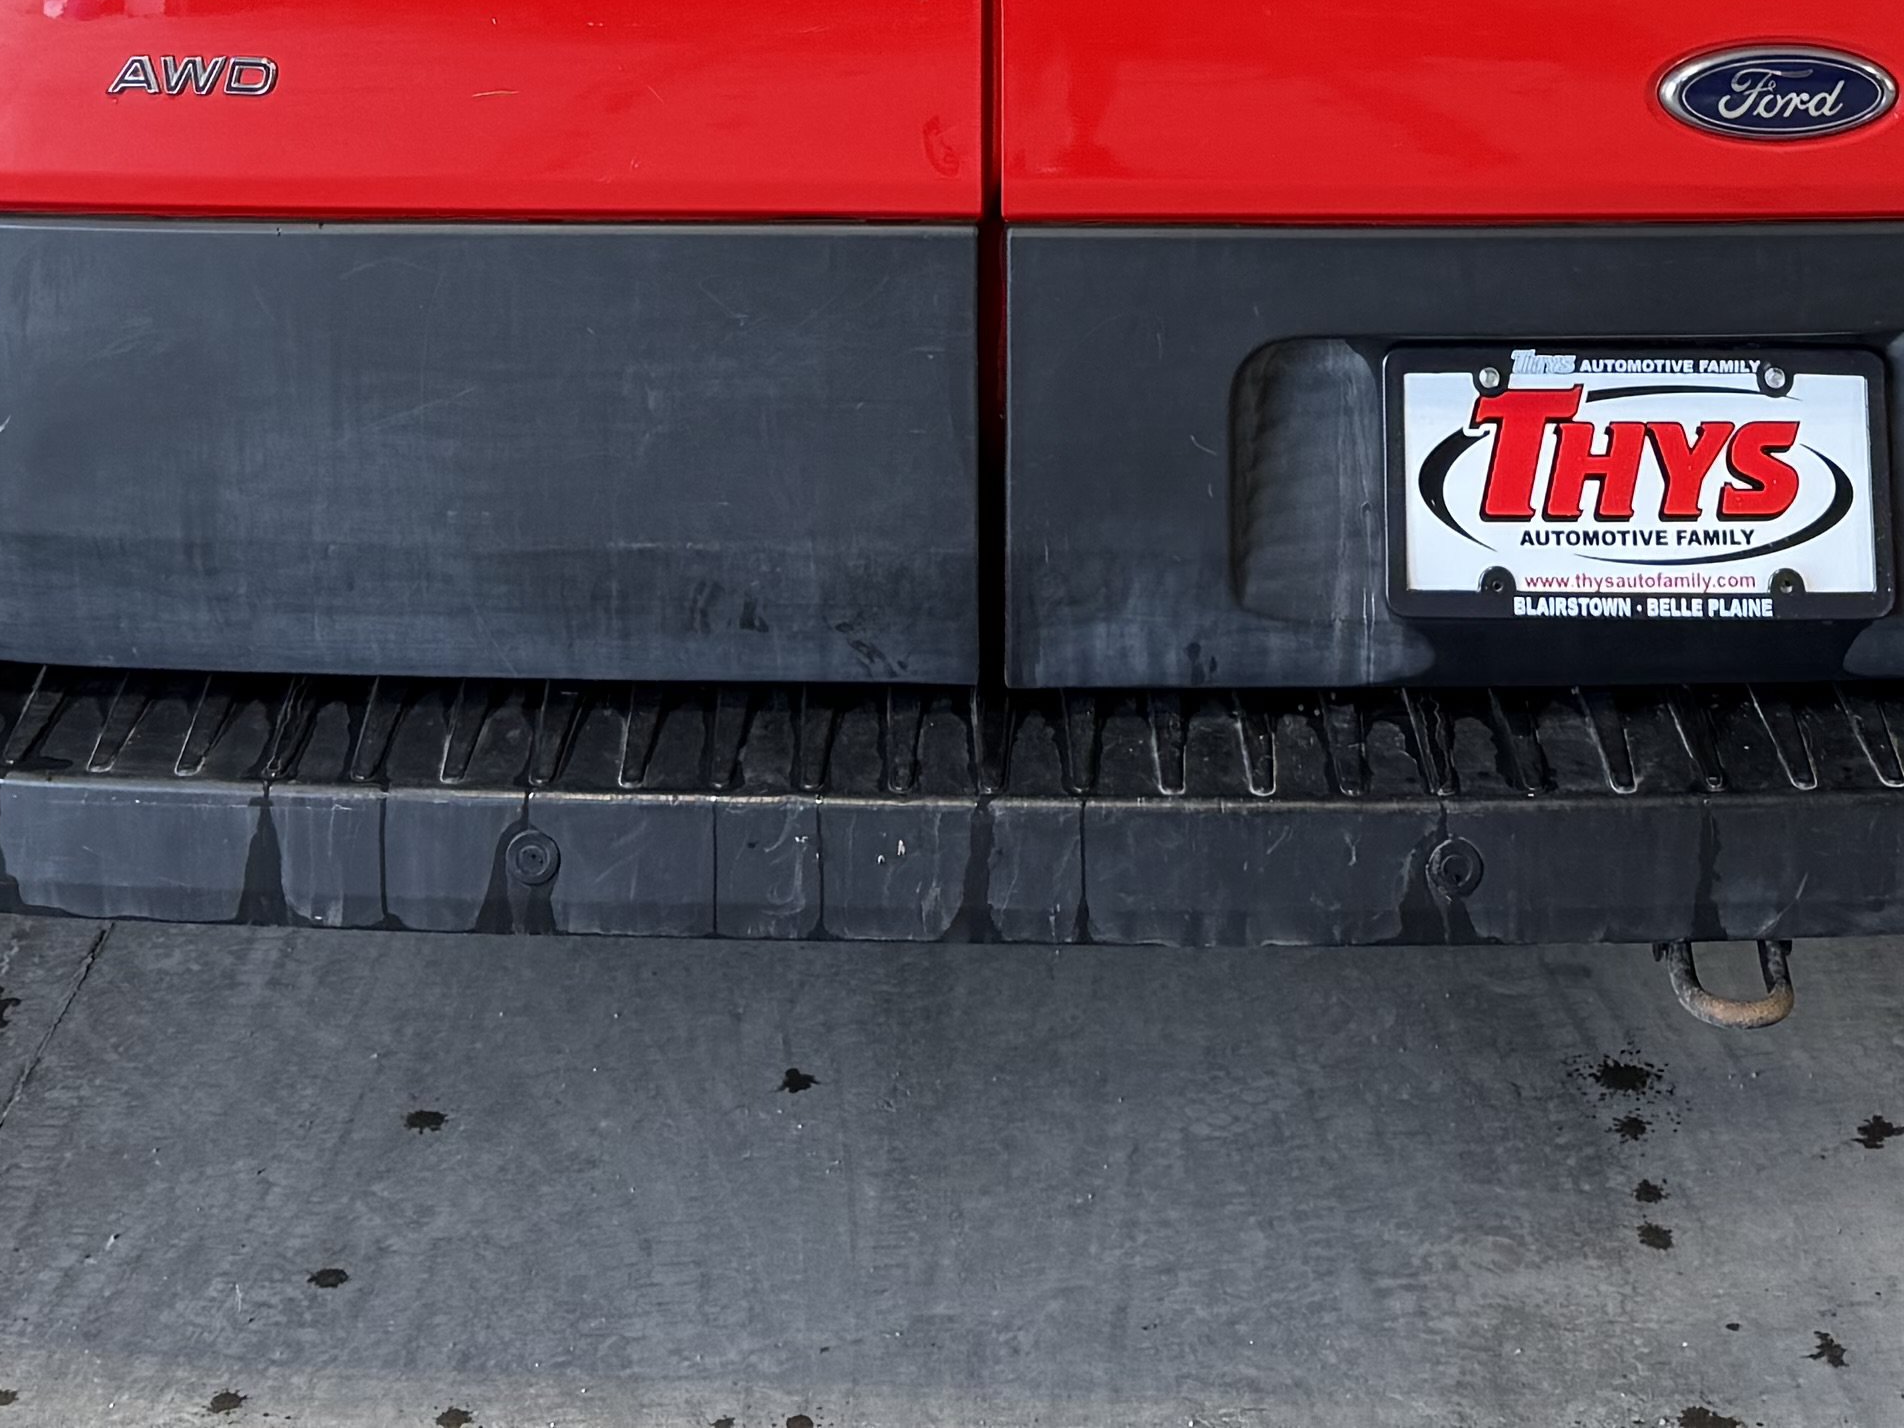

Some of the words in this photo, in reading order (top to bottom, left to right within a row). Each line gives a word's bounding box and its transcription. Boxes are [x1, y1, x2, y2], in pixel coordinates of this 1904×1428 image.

[106, 53, 280, 96] AWD
[1717, 67, 1846, 120] Ford
[1579, 358, 1695, 374] AUTOMOTIVE
[1698, 358, 1762, 374] FAMILY
[1471, 383, 1800, 522] THYS
[1520, 529, 1670, 548] AUTOMOTIVE
[1676, 528, 1756, 547] FAMILY
[1524, 571, 1757, 593] www.thysautofamily.com
[1513, 596, 1632, 618] BLAIRSTOWN
[1646, 596, 1705, 619] BELLE
[1708, 597, 1773, 619] PLAINE
